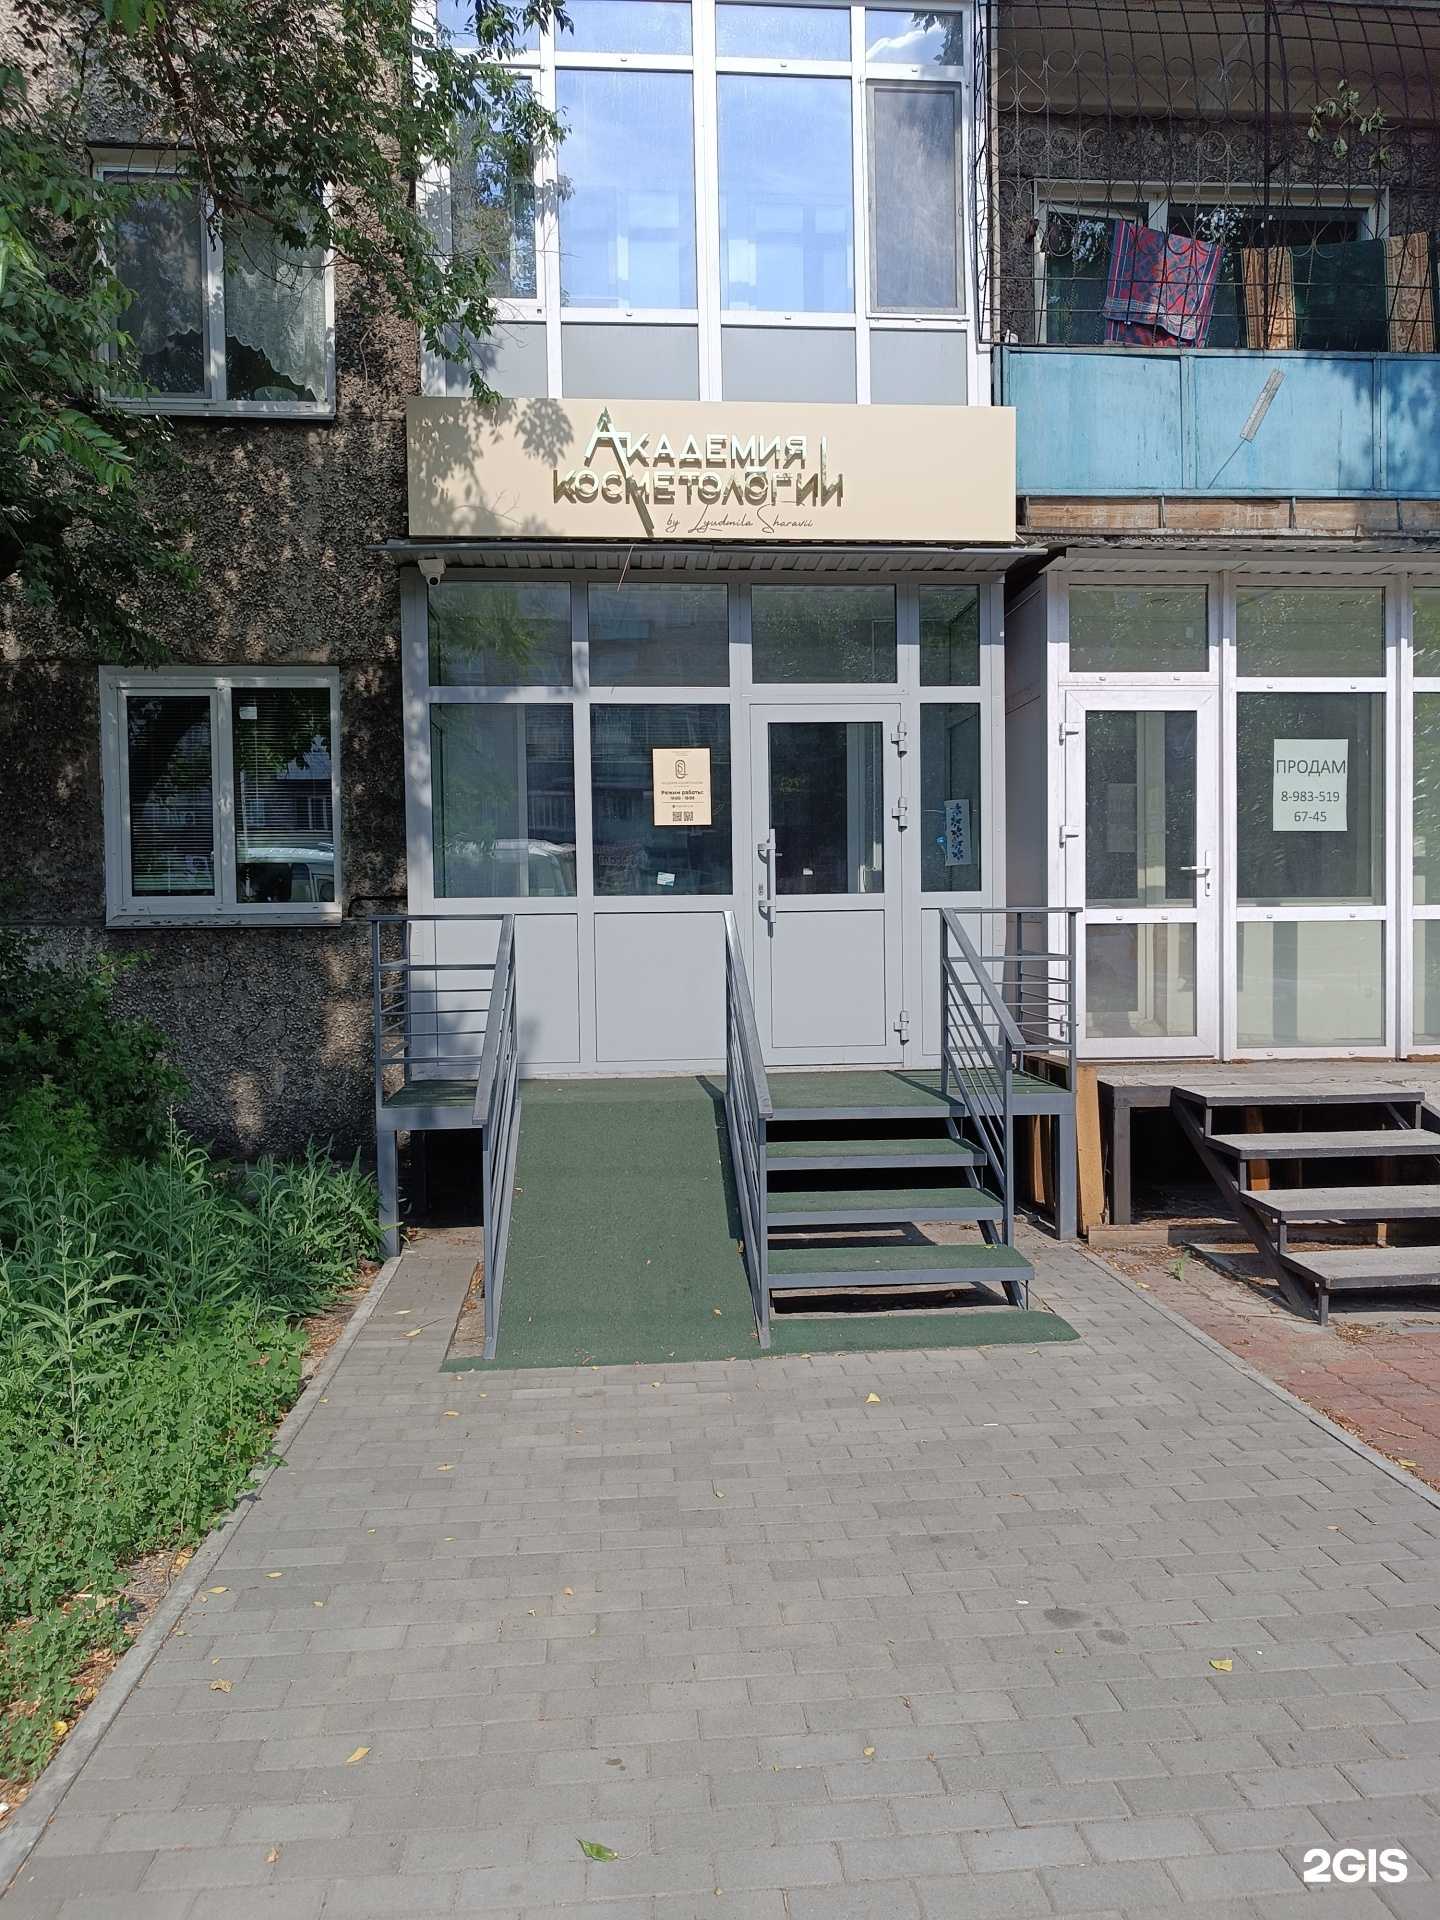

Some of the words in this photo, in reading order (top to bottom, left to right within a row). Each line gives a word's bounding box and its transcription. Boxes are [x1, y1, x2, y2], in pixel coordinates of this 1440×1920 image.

[553, 467, 843, 507] КОСМЕТОЛОГИИ
[664, 513, 681, 534] by
[1276, 759, 1346, 777] ПРОДАМ
[1281, 790, 1340, 802] 8-983-519
[1294, 811, 1327, 822] 67-45
